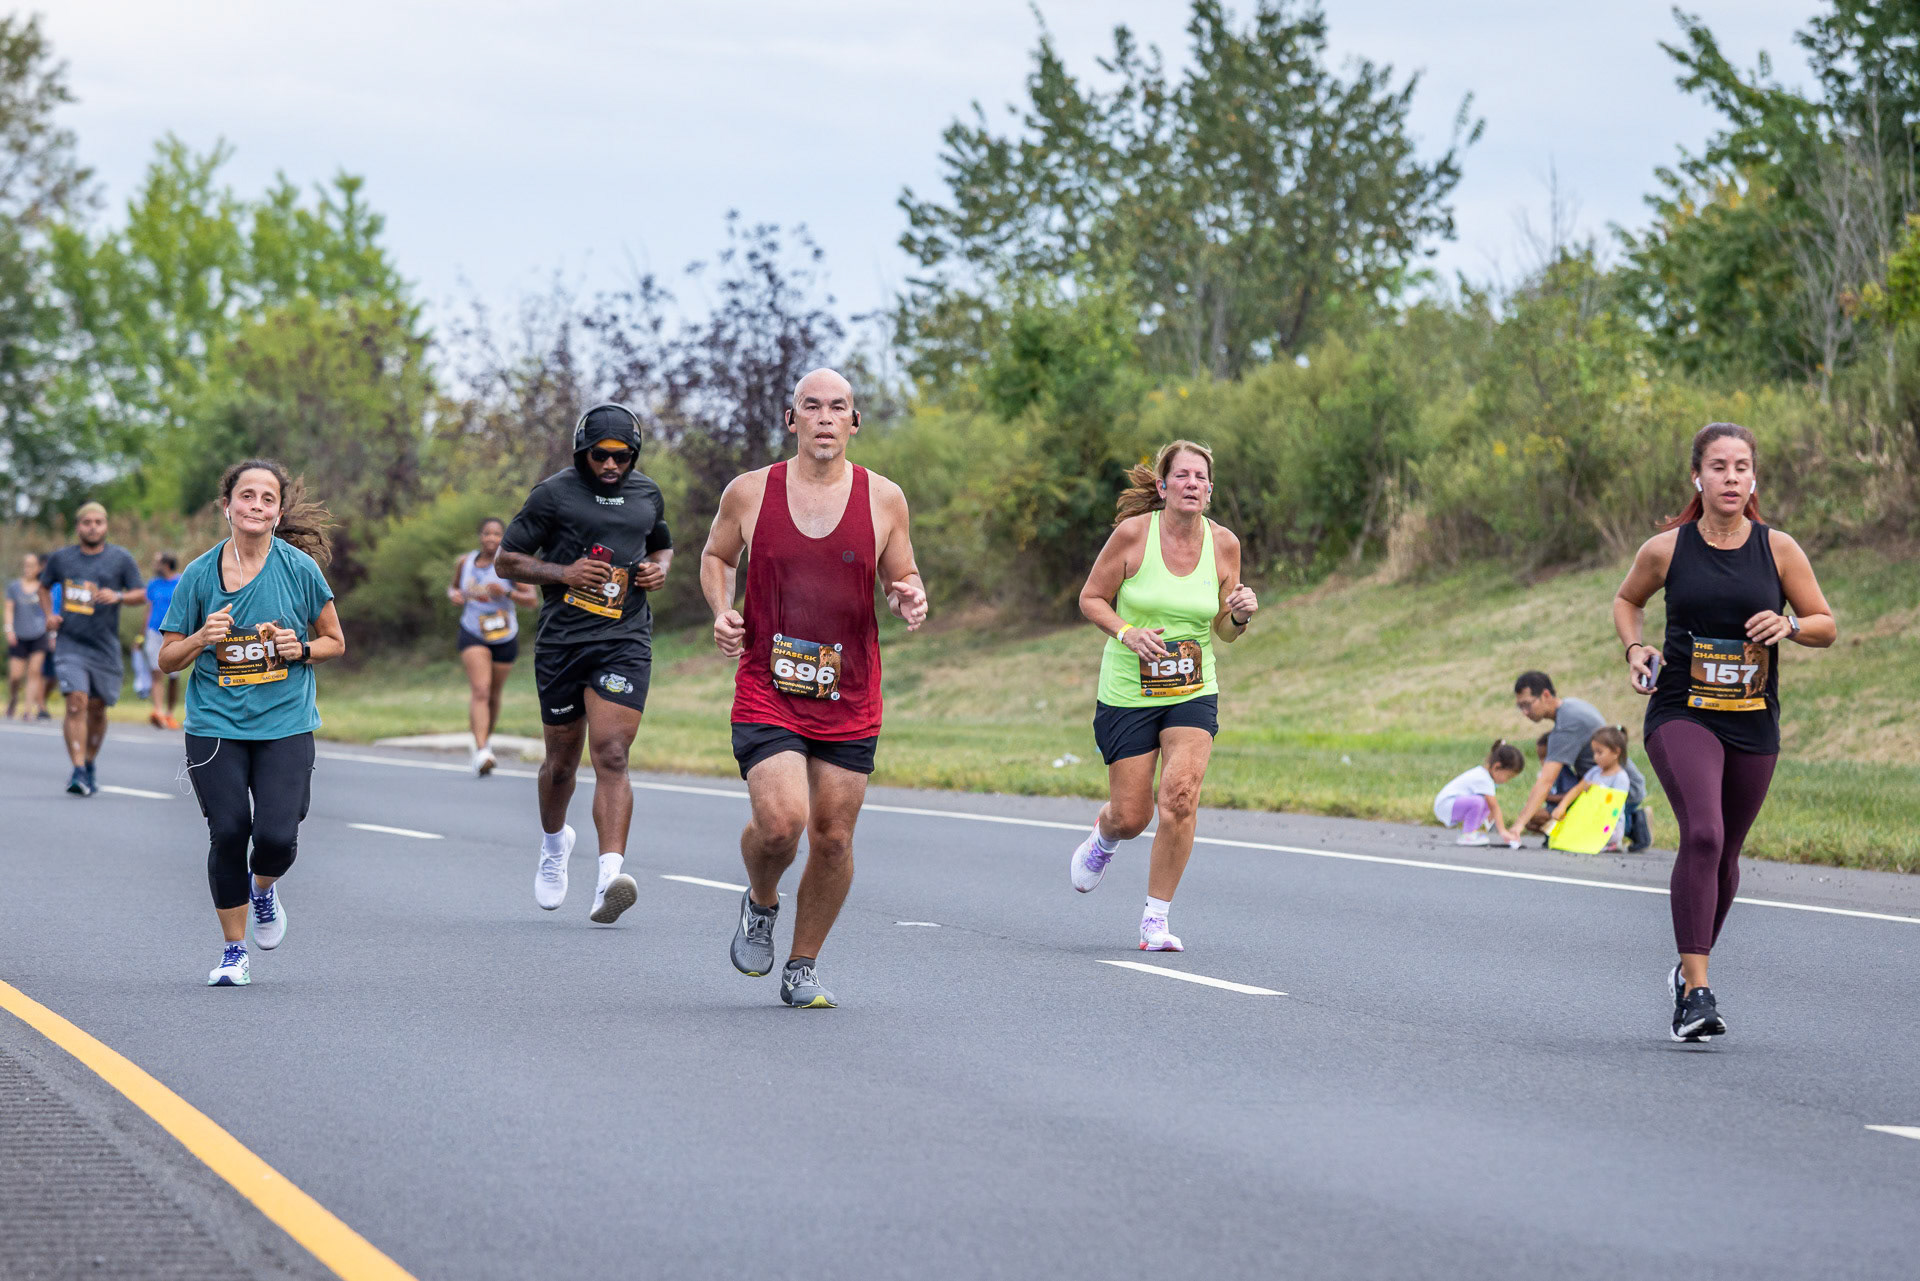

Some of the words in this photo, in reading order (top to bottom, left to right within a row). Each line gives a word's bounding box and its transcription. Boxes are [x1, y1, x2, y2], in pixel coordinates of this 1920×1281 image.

[225, 641, 275, 663] 361
[773, 648, 803, 659] CHASE
[803, 654, 817, 662] 5K
[1693, 651, 1727, 660] CHASE
[1694, 642, 1714, 650] THE
[775, 658, 836, 684] 696
[1148, 658, 1194, 677] 138
[1702, 662, 1759, 685] 157
